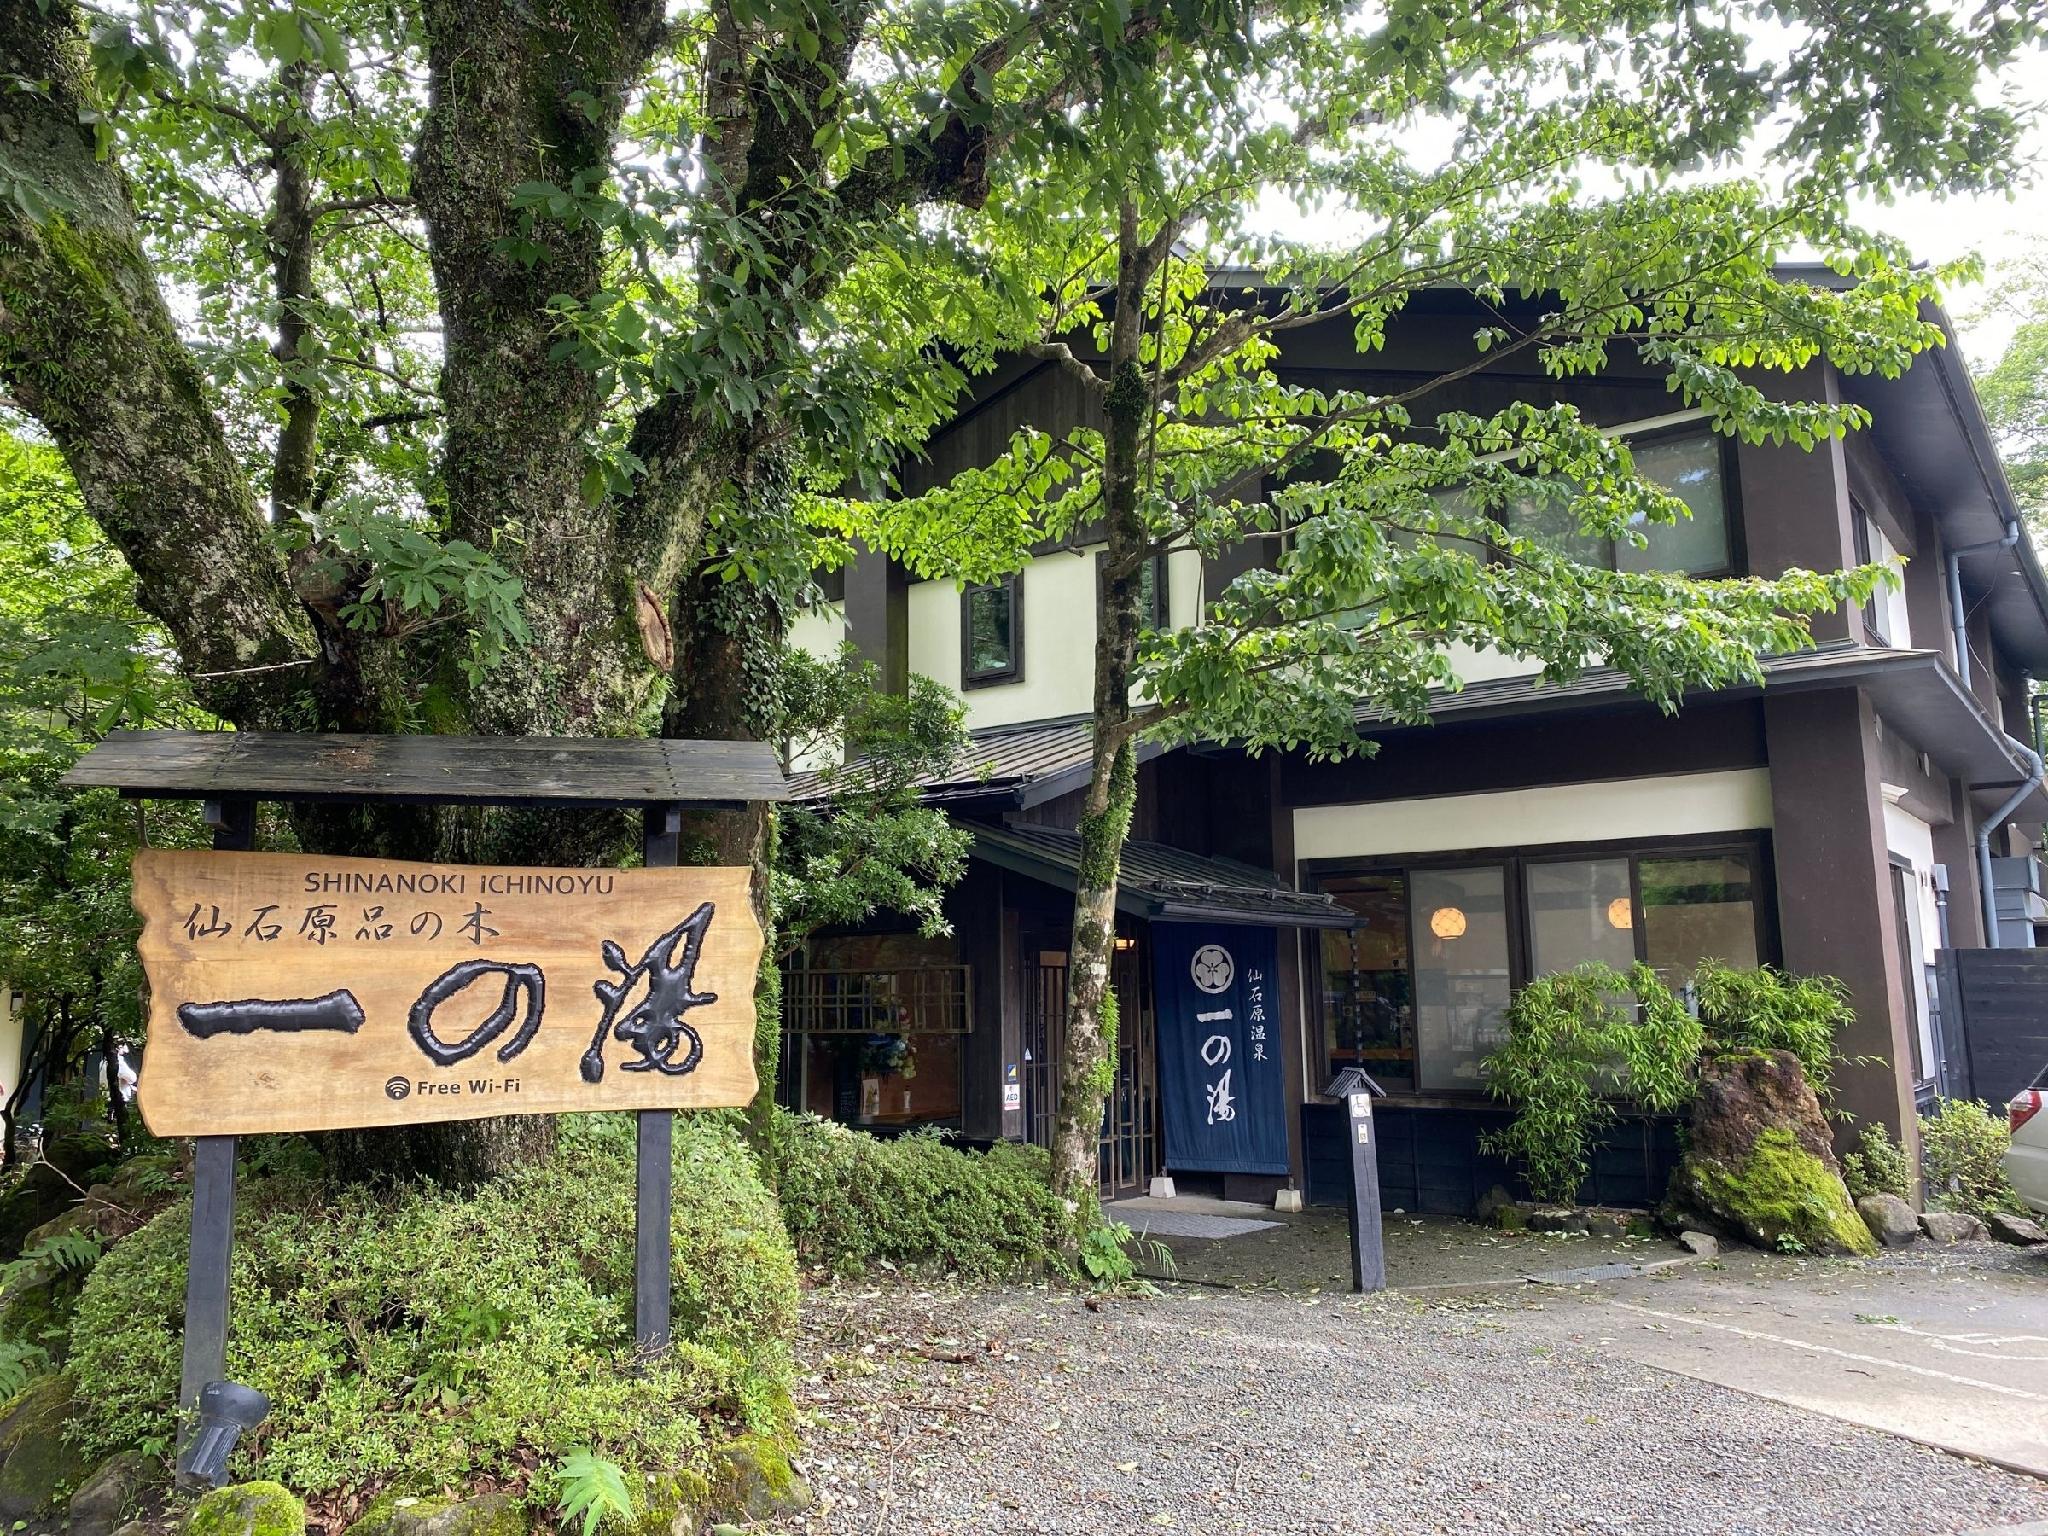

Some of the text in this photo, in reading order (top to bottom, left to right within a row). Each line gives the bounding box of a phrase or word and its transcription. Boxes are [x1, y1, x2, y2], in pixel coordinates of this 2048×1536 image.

[304, 872, 613, 895] SHINANOKI ICHINOYU
[183, 901, 500, 946] 仙石原品の木
[177, 902, 718, 1084] 一の湯
[1247, 968, 1268, 1061] 仙石原温泉
[417, 1078, 520, 1095] Free Wi-Fi
[1196, 1008, 1236, 1125] 一の湯
